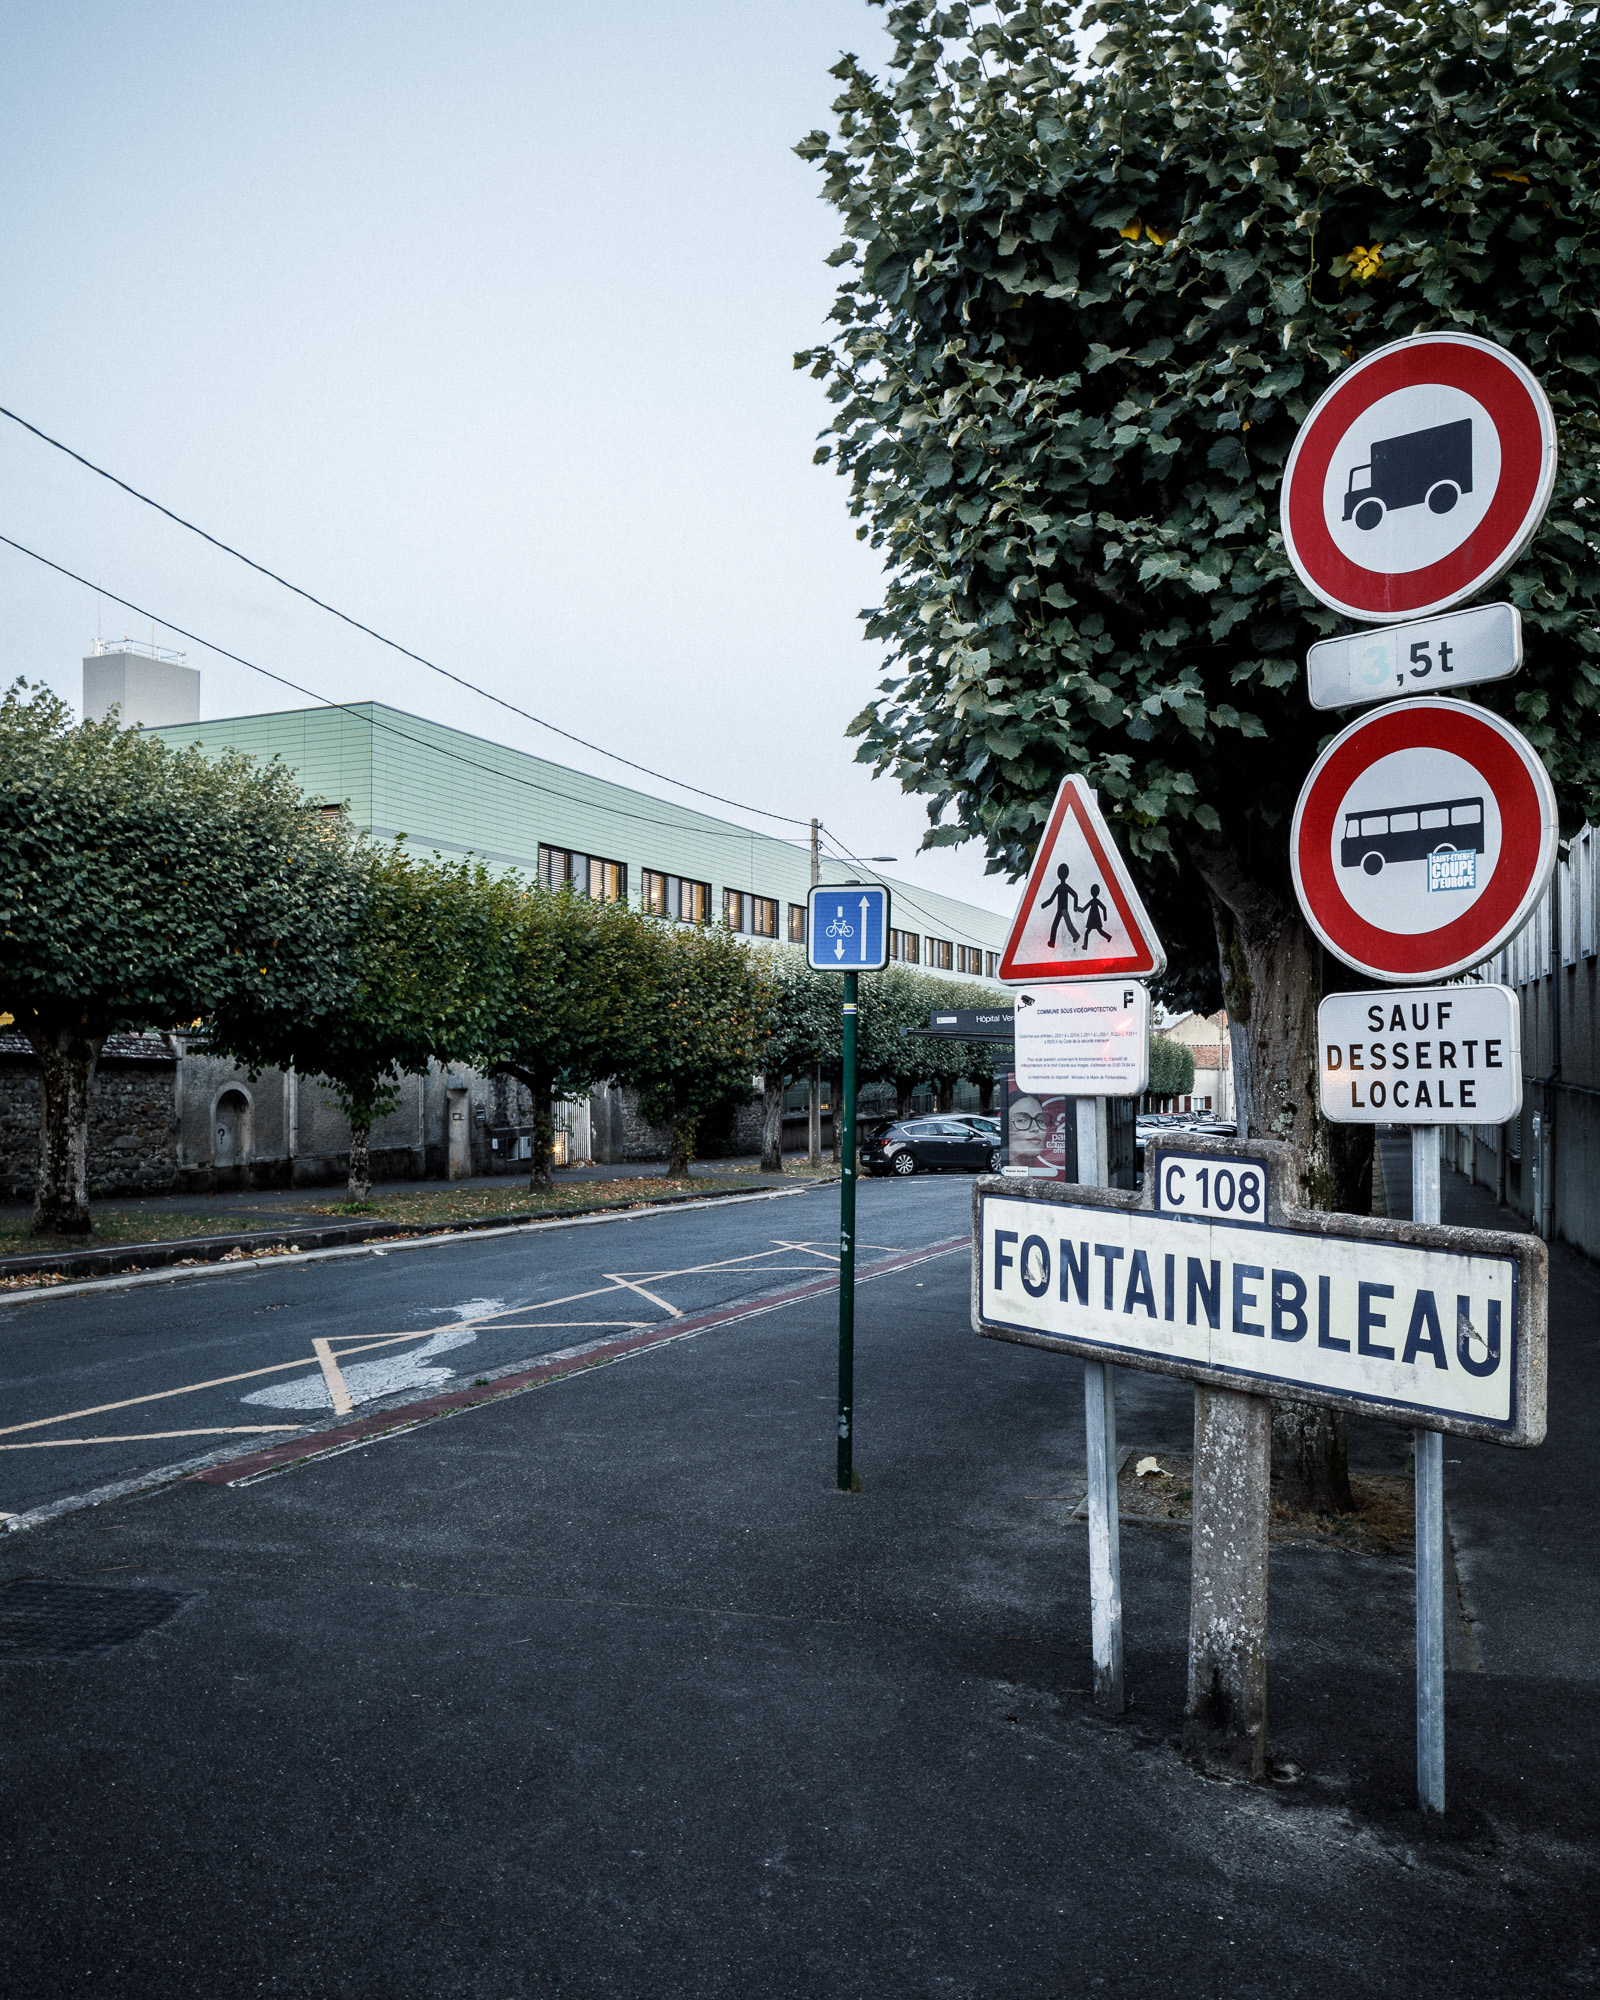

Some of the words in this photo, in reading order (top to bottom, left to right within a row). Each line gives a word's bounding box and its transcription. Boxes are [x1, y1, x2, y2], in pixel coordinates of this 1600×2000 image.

[1432, 860, 1475, 879] COUPE
[1432, 875, 1475, 890] D'EUROPE
[976, 1014, 1000, 1024] Hôpital
[1367, 1001, 1453, 1033] SAUF
[1327, 1039, 1503, 1071] DESSERTE
[1351, 1079, 1477, 1108] LOCALE
[1166, 1165, 1186, 1207] C
[1196, 1168, 1261, 1215] 108
[994, 1229, 1502, 1378] FONTAINEBLEAU
